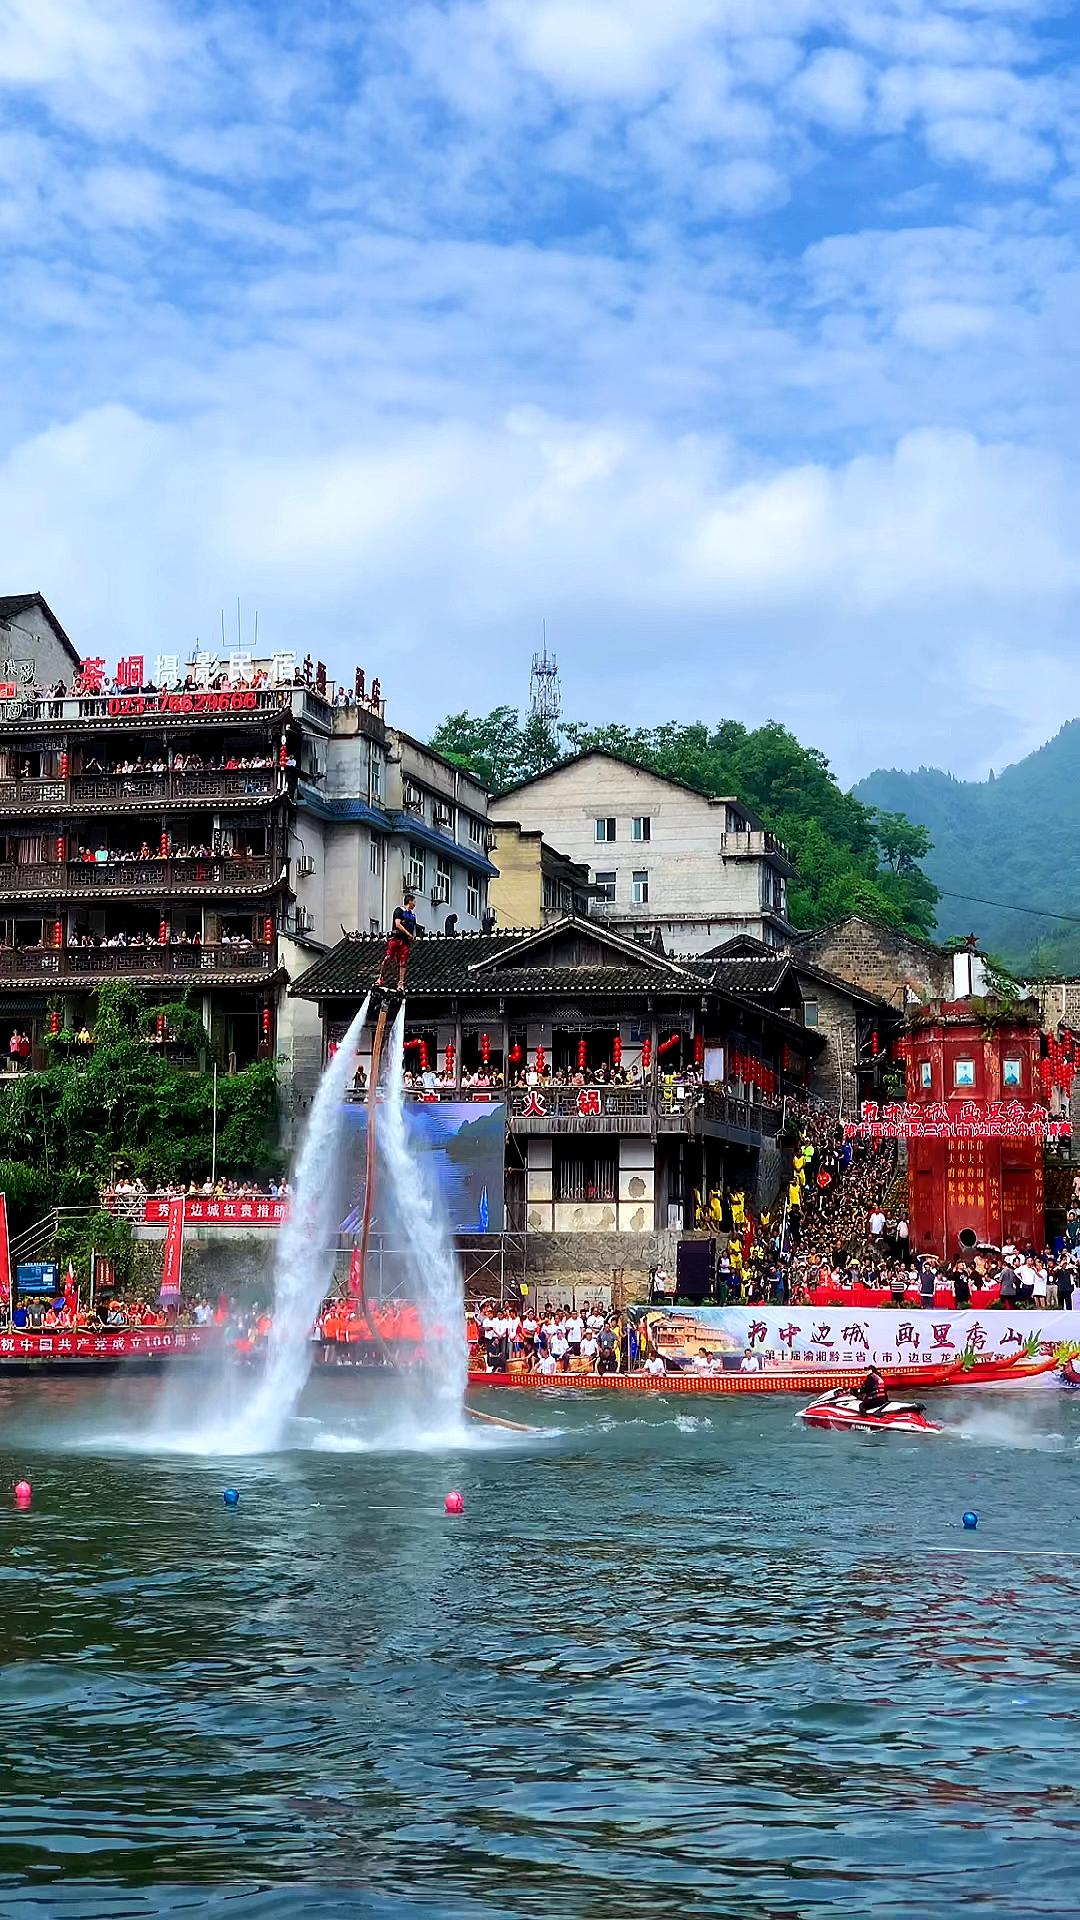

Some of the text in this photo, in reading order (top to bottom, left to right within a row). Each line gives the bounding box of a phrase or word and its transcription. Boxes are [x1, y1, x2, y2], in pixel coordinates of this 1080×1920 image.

[522, 1090, 602, 1117] 火锅
[748, 1320, 1024, 1351] 书中边城 画里秀山
